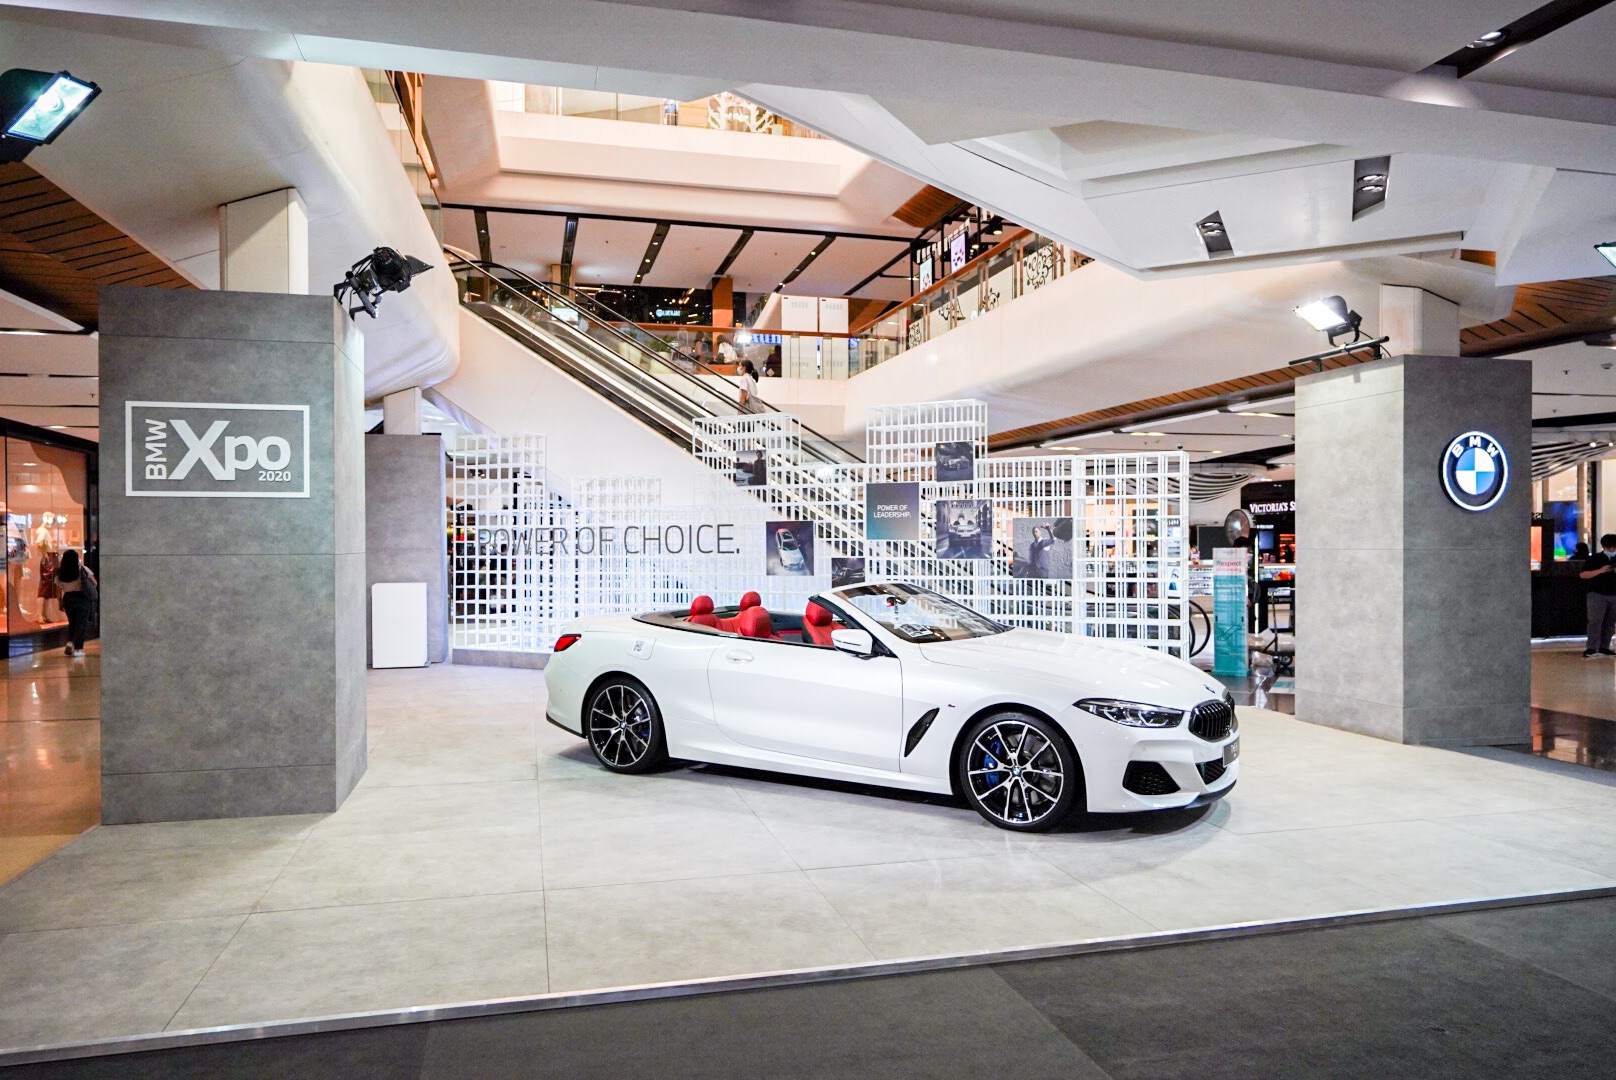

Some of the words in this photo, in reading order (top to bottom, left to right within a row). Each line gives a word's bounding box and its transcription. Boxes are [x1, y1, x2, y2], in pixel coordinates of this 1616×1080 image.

[145, 418, 167, 480] BMW
[168, 419, 291, 481] Xpo
[1451, 436, 1499, 458] BMW
[258, 470, 292, 482] 2020
[1249, 502, 1288, 513] VICTORIA'S
[478, 527, 569, 556] POWER
[577, 526, 615, 555] OF
[623, 524, 740, 554] CHOICE.
